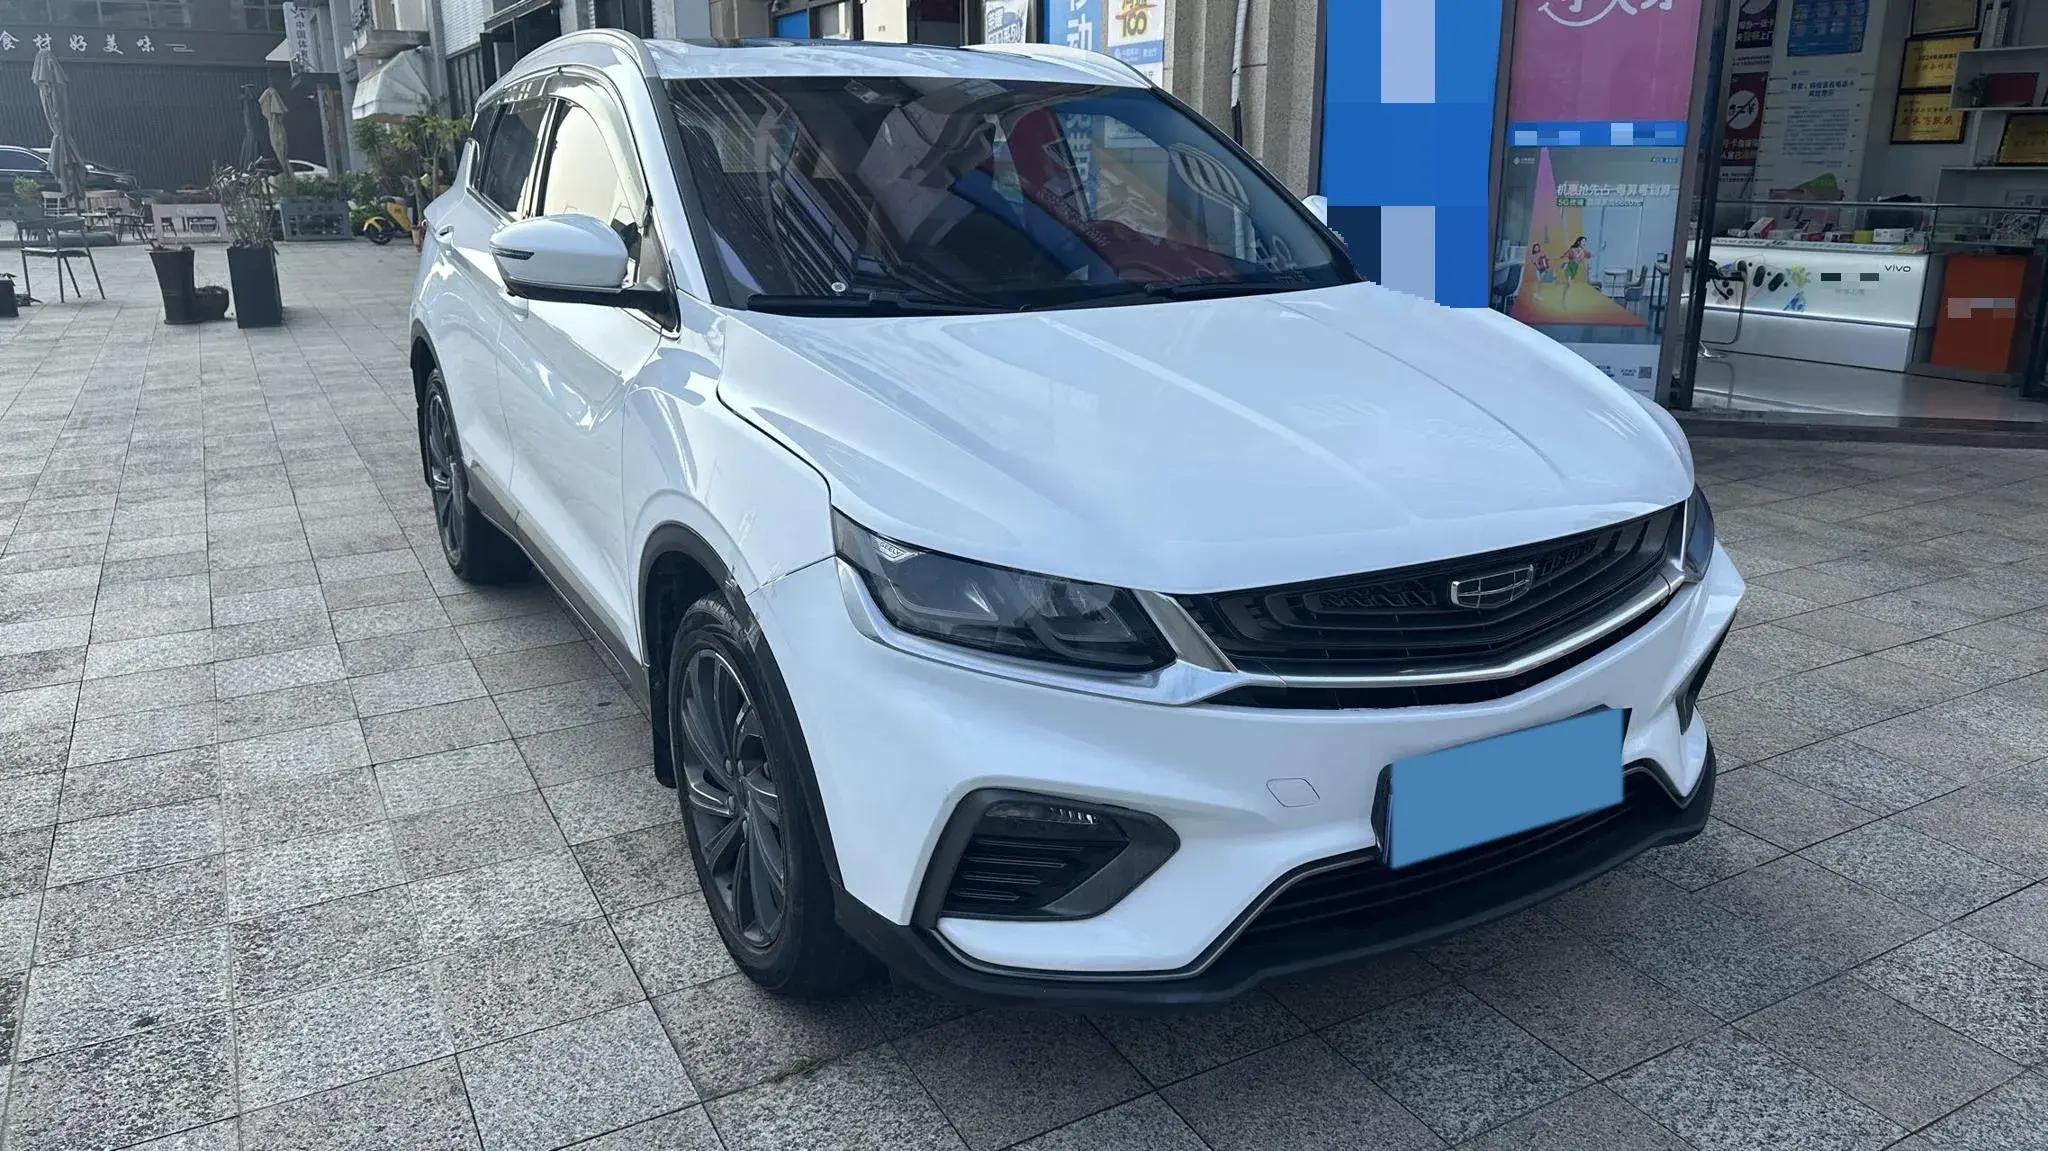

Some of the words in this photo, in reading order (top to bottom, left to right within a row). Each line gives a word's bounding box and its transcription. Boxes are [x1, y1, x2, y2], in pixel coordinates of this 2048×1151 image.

[1122, 11, 1148, 37] 100
[0, 30, 154, 55] 食材好美味
[1885, 264, 1911, 273] vivo
[880, 541, 901, 556] GEELY
